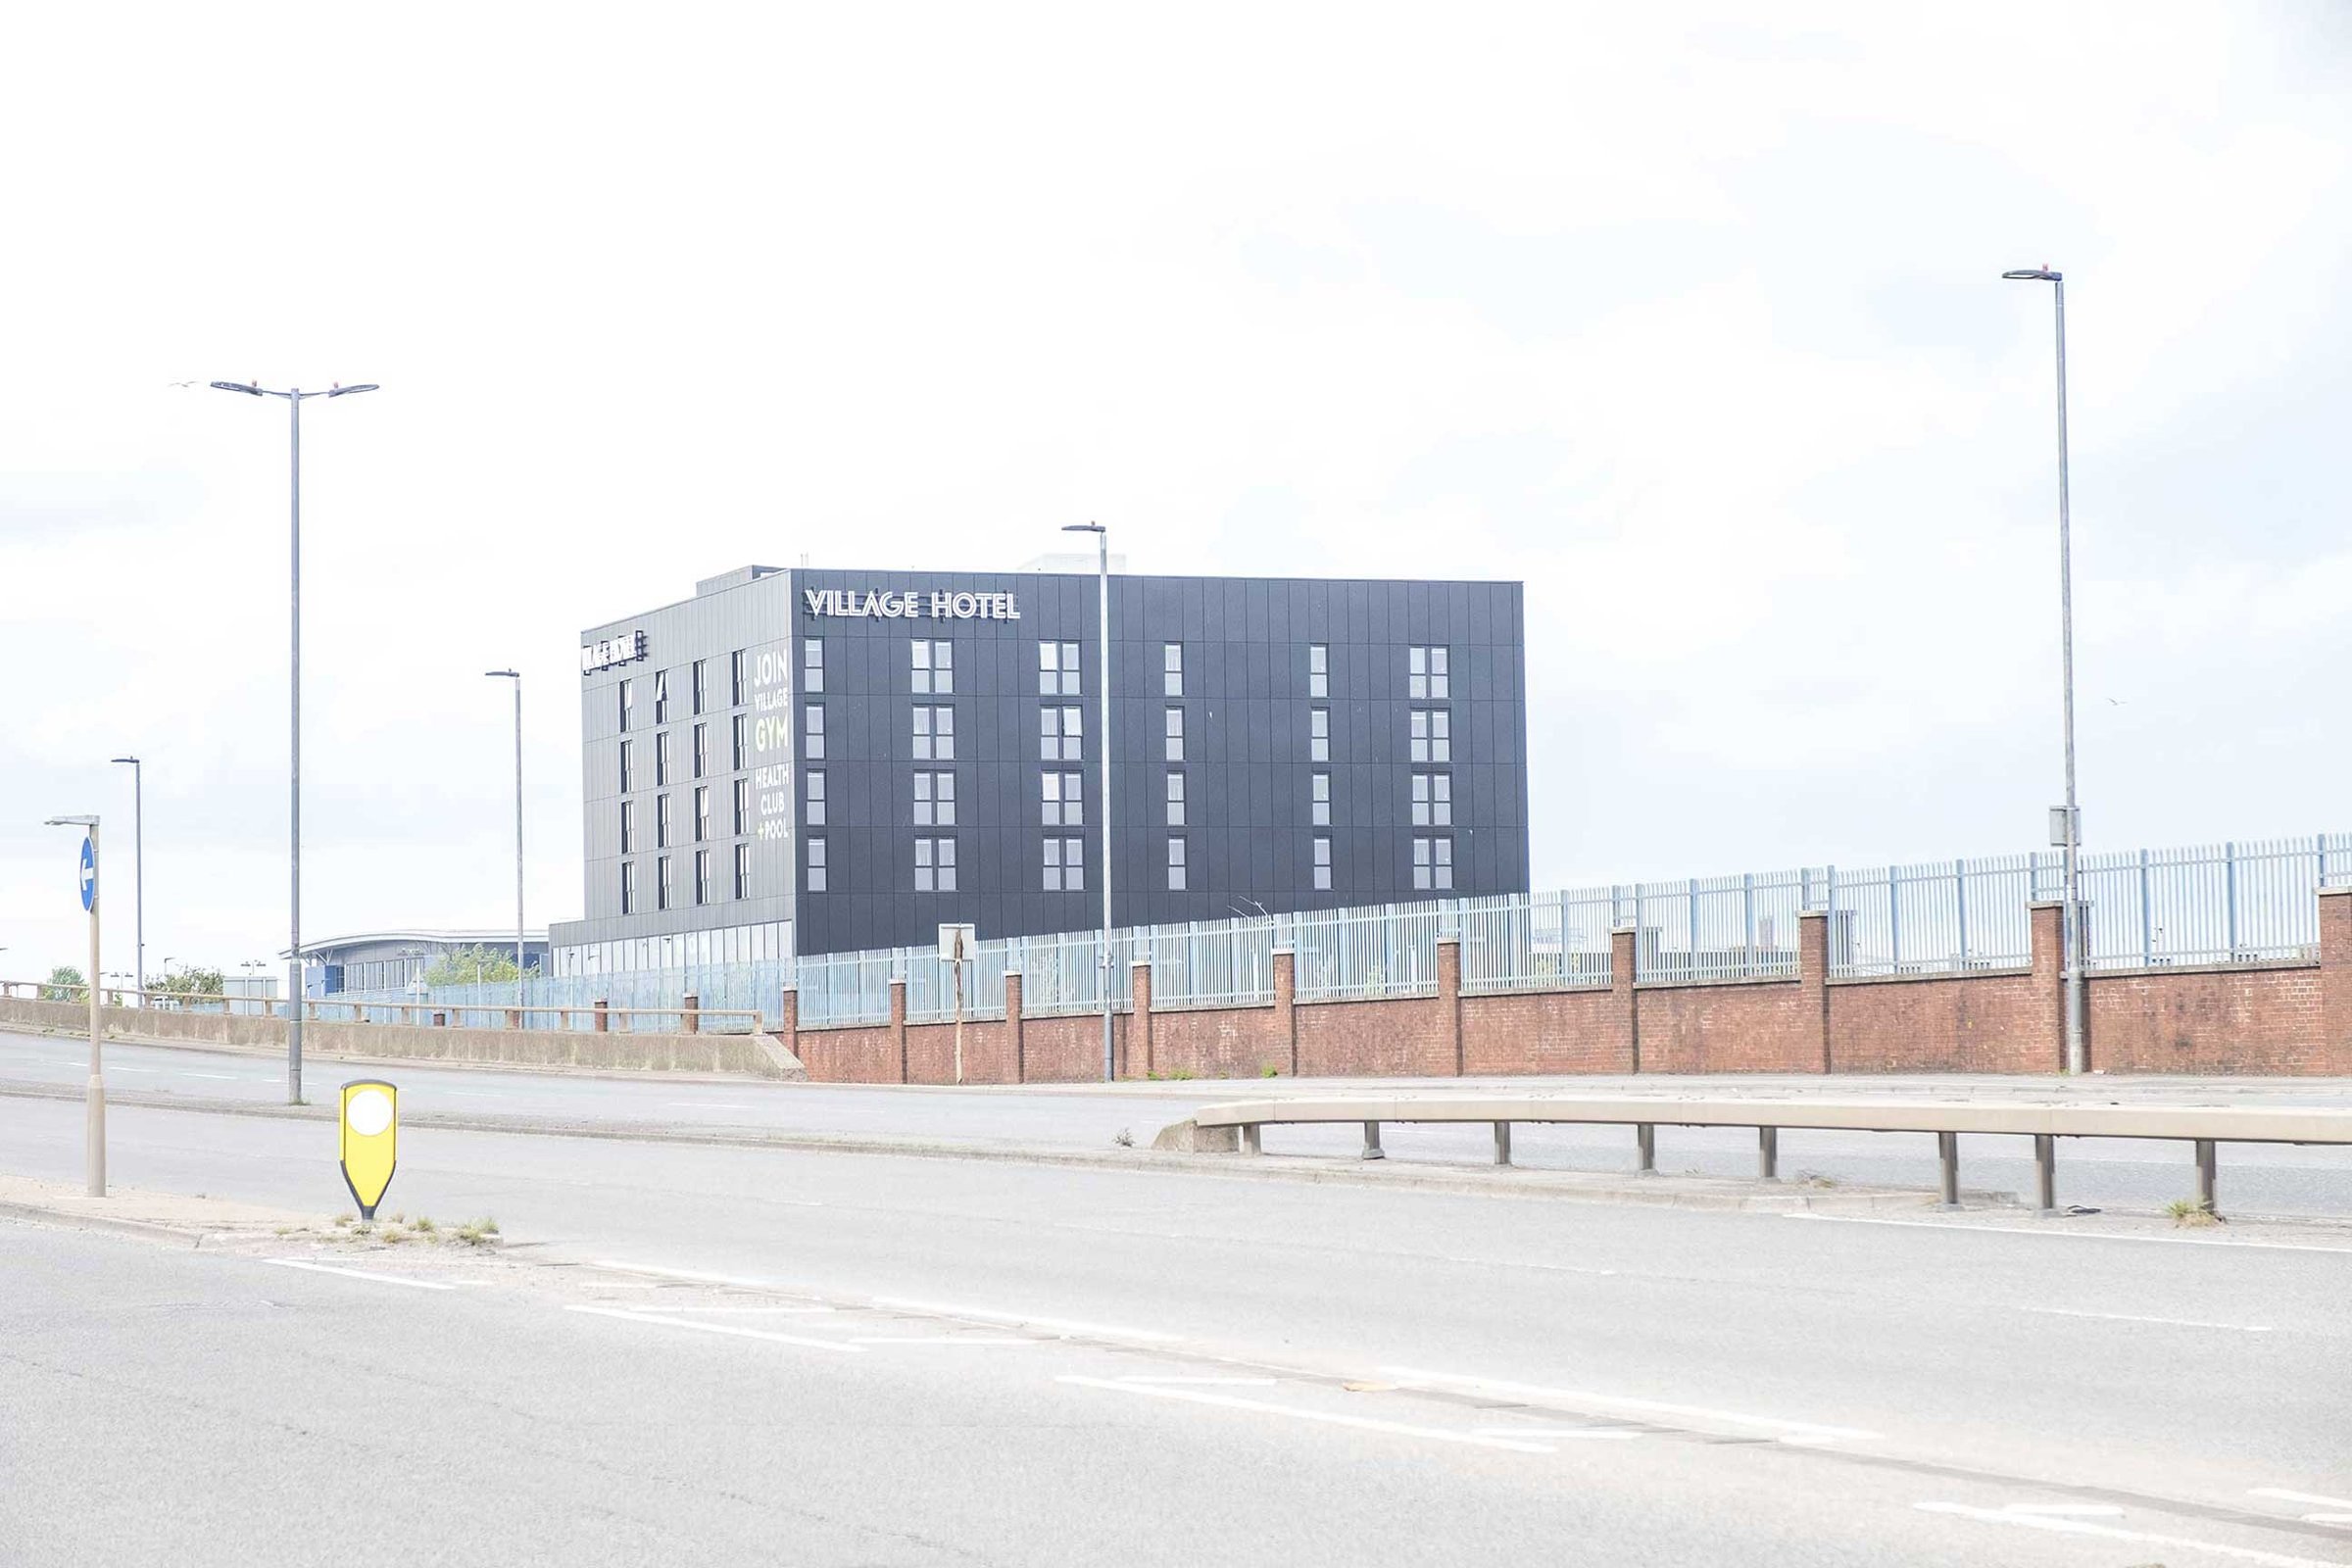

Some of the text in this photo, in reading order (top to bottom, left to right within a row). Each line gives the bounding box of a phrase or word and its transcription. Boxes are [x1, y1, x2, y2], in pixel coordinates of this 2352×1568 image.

[805, 590, 1021, 619] VILLAGE HOTEL
[754, 649, 788, 687] JOIN
[754, 687, 788, 712] VILLAGE
[755, 715, 789, 753] GYM
[755, 763, 789, 791] HEALTH
[760, 792, 785, 816] CLUB
